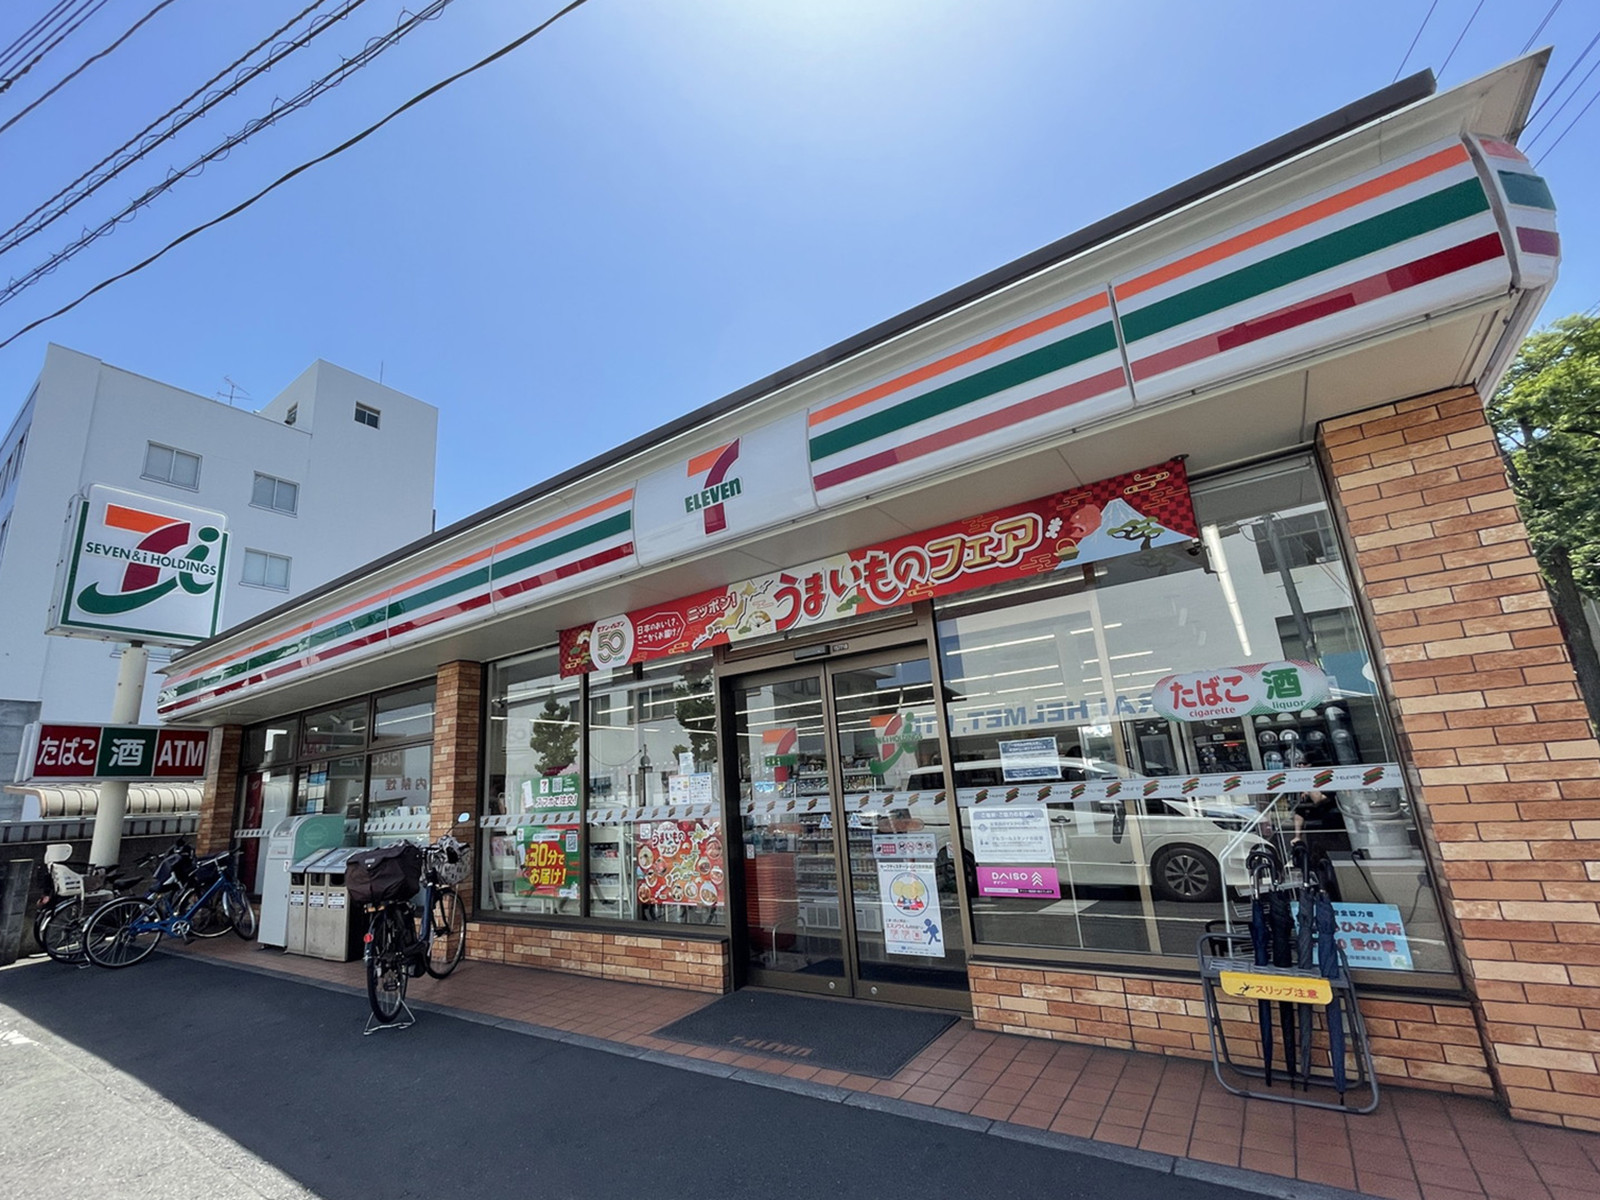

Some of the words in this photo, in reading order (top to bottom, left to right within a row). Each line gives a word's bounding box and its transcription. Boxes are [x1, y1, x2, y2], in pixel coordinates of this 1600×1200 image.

[150, 553, 218, 577] HOLDINGS
[772, 517, 1037, 630] うまいものフェア
[597, 628, 627, 664] 50
[1169, 674, 1250, 710] たばこ
[1262, 667, 1303, 700] 酒
[1189, 706, 1236, 718] cigarette
[1271, 699, 1306, 711] liquor
[37, 735, 97, 766] たばこ
[108, 737, 147, 768] 酒
[156, 739, 206, 767] ATM
[529, 868, 567, 885] お届け!
[991, 871, 1028, 881] DAISO
[1256, 984, 1319, 999] スリップ注意
